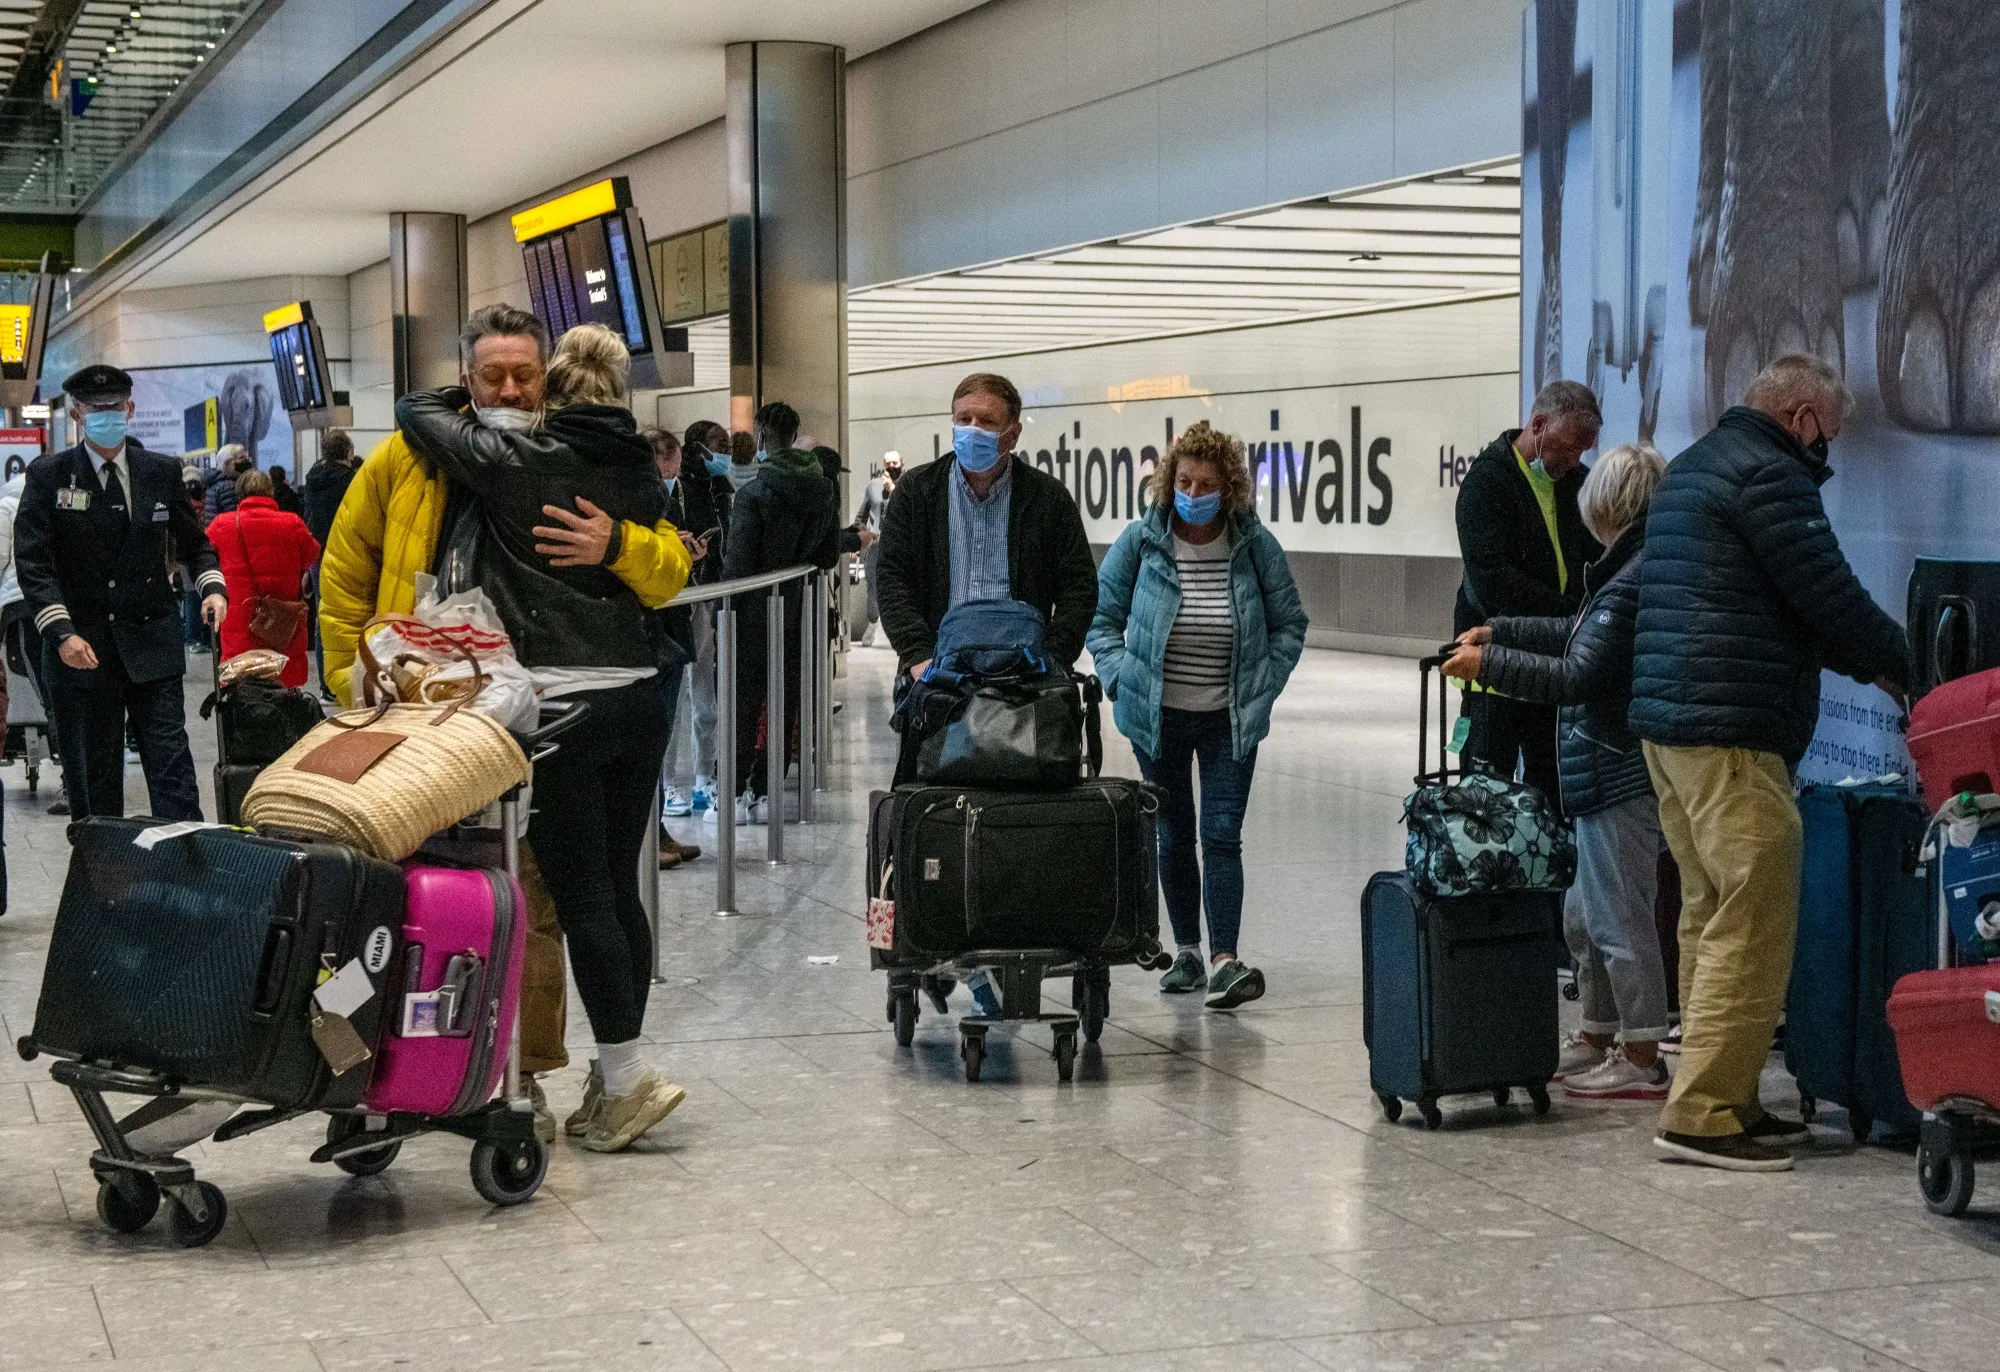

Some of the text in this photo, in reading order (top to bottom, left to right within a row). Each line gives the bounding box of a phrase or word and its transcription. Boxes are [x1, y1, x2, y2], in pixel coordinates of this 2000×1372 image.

[207, 408, 216, 427] A
[1200, 407, 1392, 526] rivals
[1850, 698, 1869, 726] from
[1870, 704, 1883, 731] the
[1831, 740, 1840, 763] to
[1841, 744, 1857, 772] stop
[370, 931, 388, 968] MIAMI
